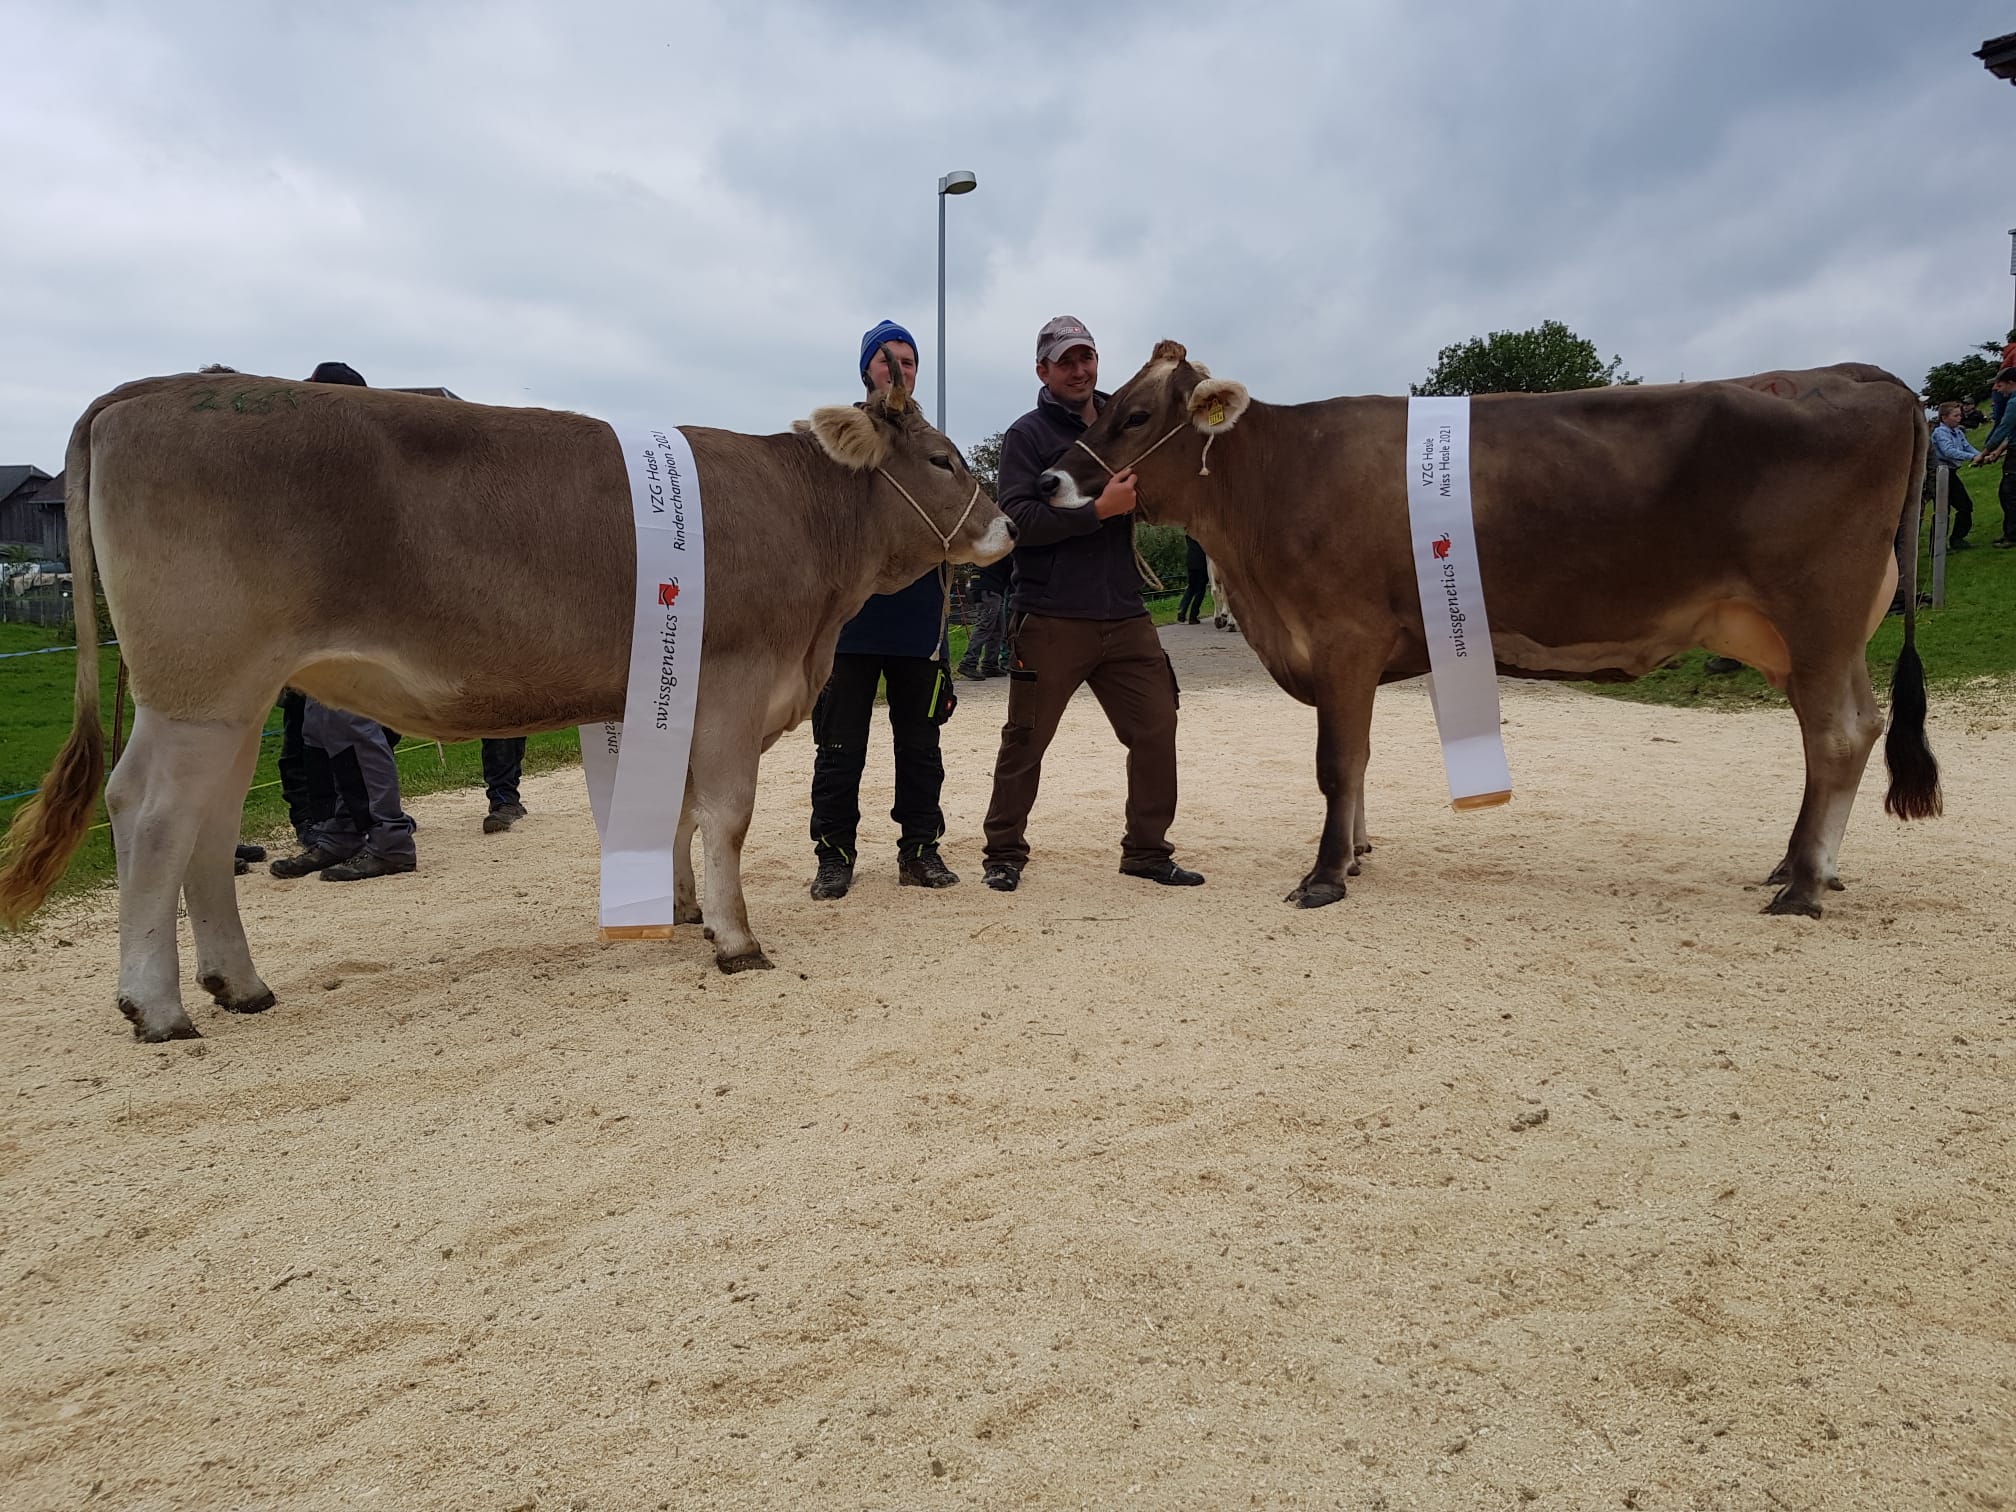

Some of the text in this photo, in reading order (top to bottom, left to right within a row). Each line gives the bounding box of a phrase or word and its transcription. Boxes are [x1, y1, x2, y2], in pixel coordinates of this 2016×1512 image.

[643, 449, 665, 514] VZG Hasle
[650, 430, 686, 551] Rinderchampion 2021
[1422, 438, 1434, 487] VZG Hasle
[1439, 425, 1451, 497] Miss Hasle 2021
[1441, 564, 1466, 657] swissgenetics
[653, 614, 678, 730] swissgenetics
